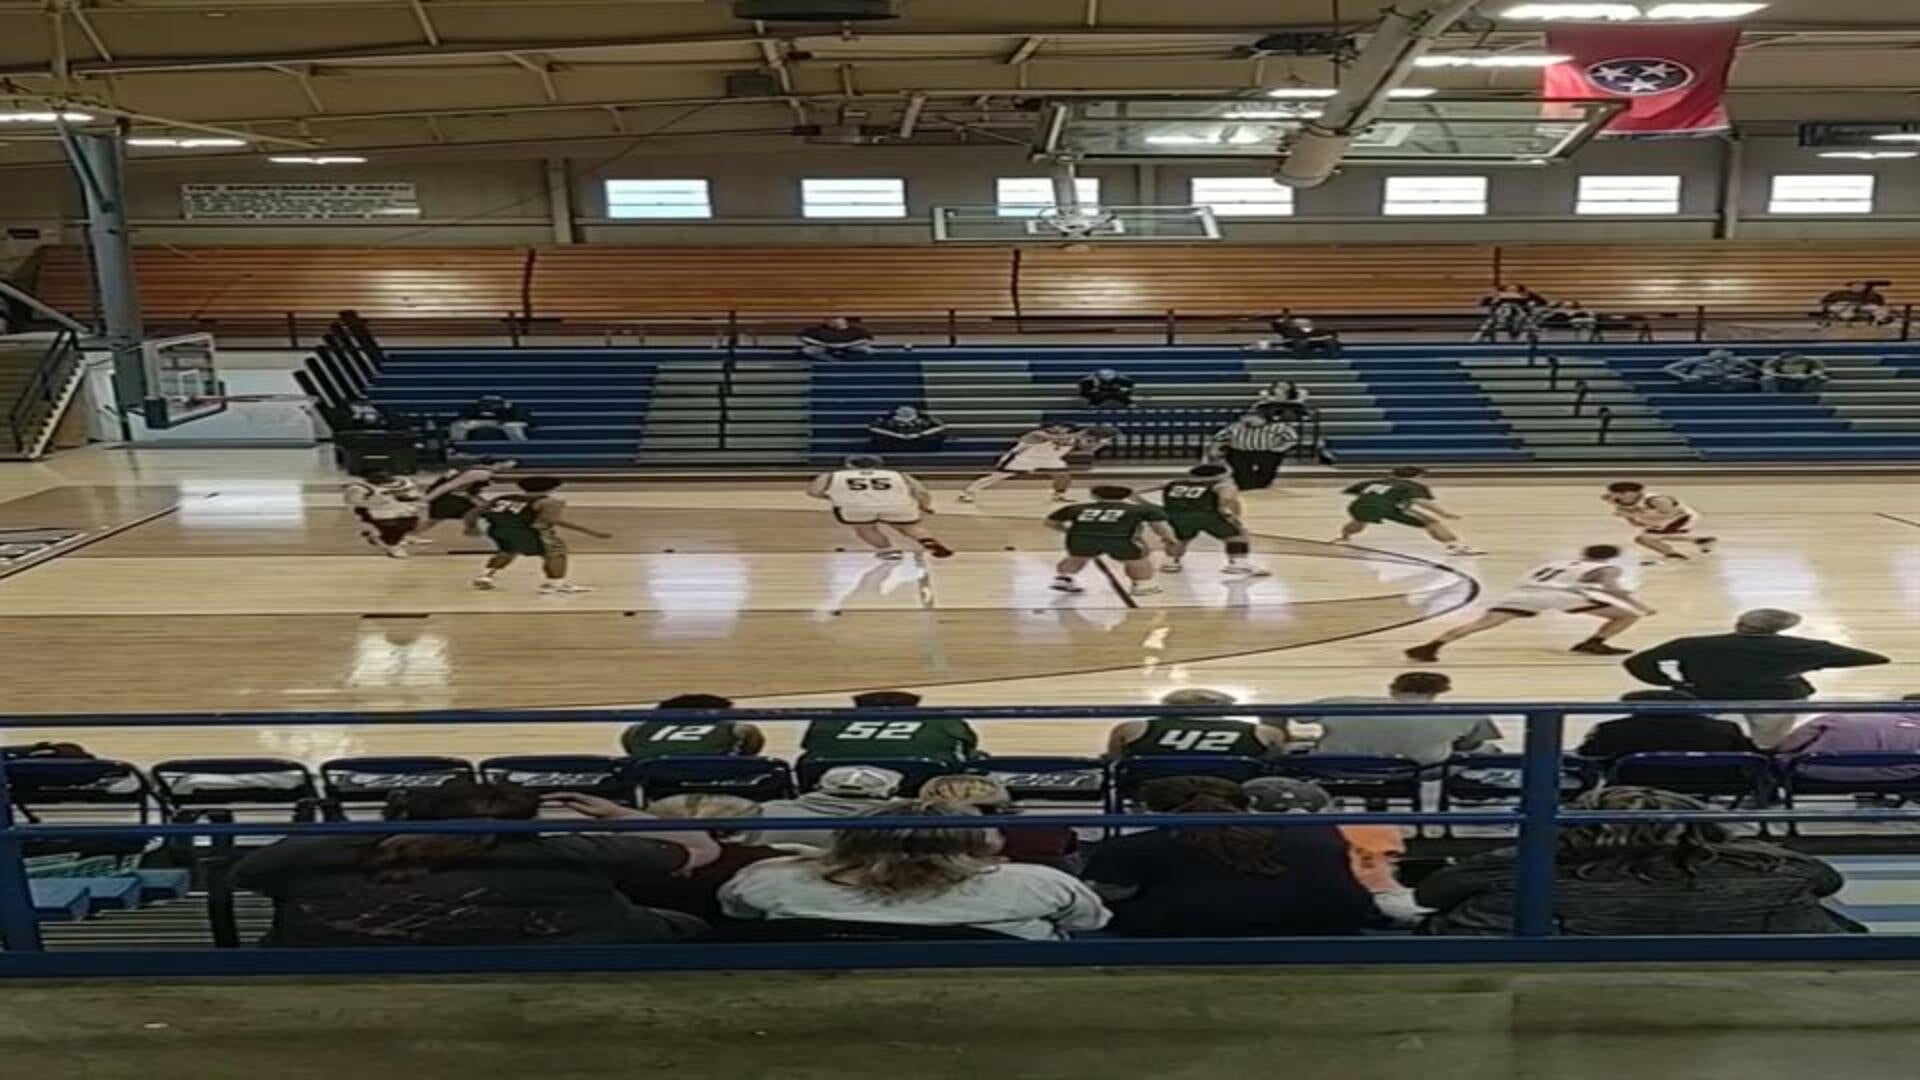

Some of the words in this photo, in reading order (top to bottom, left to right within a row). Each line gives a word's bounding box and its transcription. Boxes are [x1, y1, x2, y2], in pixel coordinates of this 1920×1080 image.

[845, 478, 892, 491] 55
[1167, 485, 1206, 499] 20
[1077, 509, 1125, 522] 22
[650, 725, 716, 741] 12
[836, 721, 922, 739] 52
[1159, 729, 1241, 751] 42
